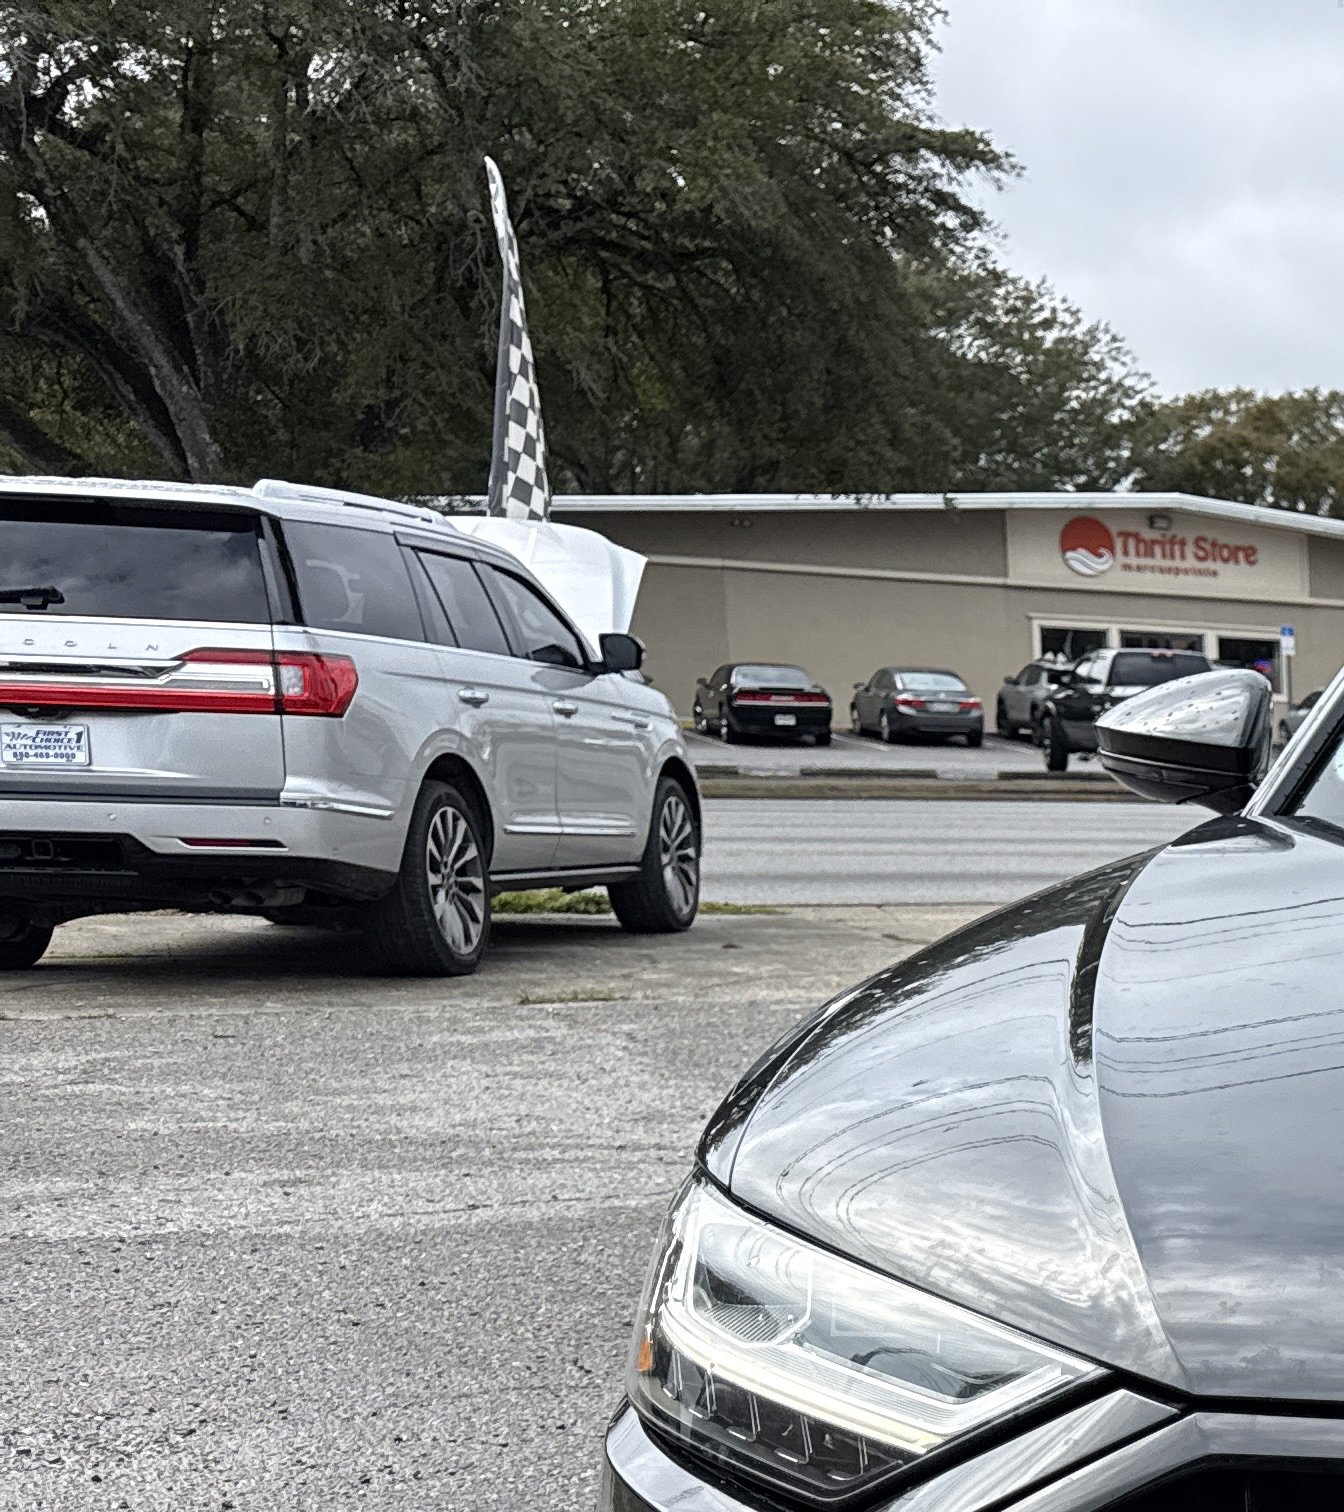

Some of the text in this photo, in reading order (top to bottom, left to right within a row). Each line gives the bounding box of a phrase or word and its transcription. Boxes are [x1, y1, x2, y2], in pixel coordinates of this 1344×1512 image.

[1116, 531, 1259, 567] Thrift Store
[35, 729, 72, 738] FIRST
[4, 743, 84, 751] AUTOMOTIVE
